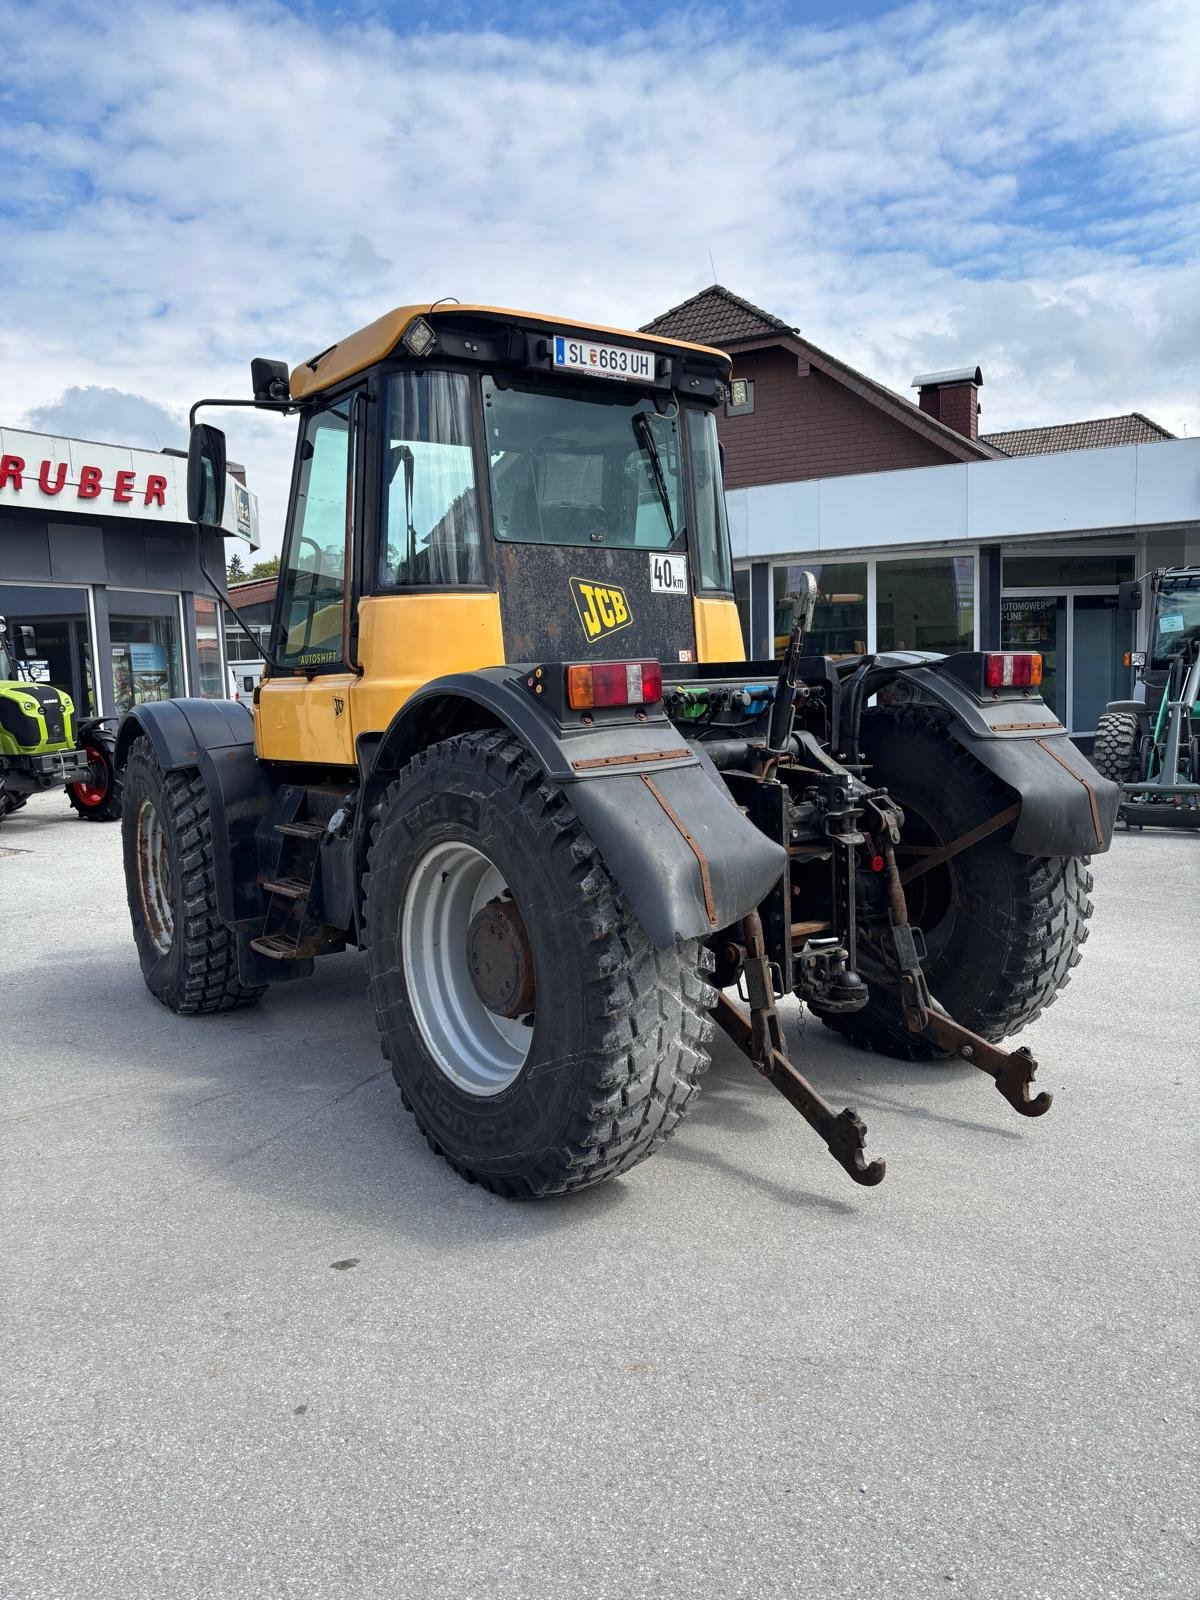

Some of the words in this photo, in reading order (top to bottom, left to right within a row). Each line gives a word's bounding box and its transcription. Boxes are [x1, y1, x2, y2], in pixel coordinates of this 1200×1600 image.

[569, 343, 587, 366] SL
[599, 349, 628, 372] 663
[631, 354, 649, 376] UH
[0, 454, 168, 507] RUBER
[578, 583, 628, 637] JCB
[300, 652, 337, 665] AUTOSHIFT
